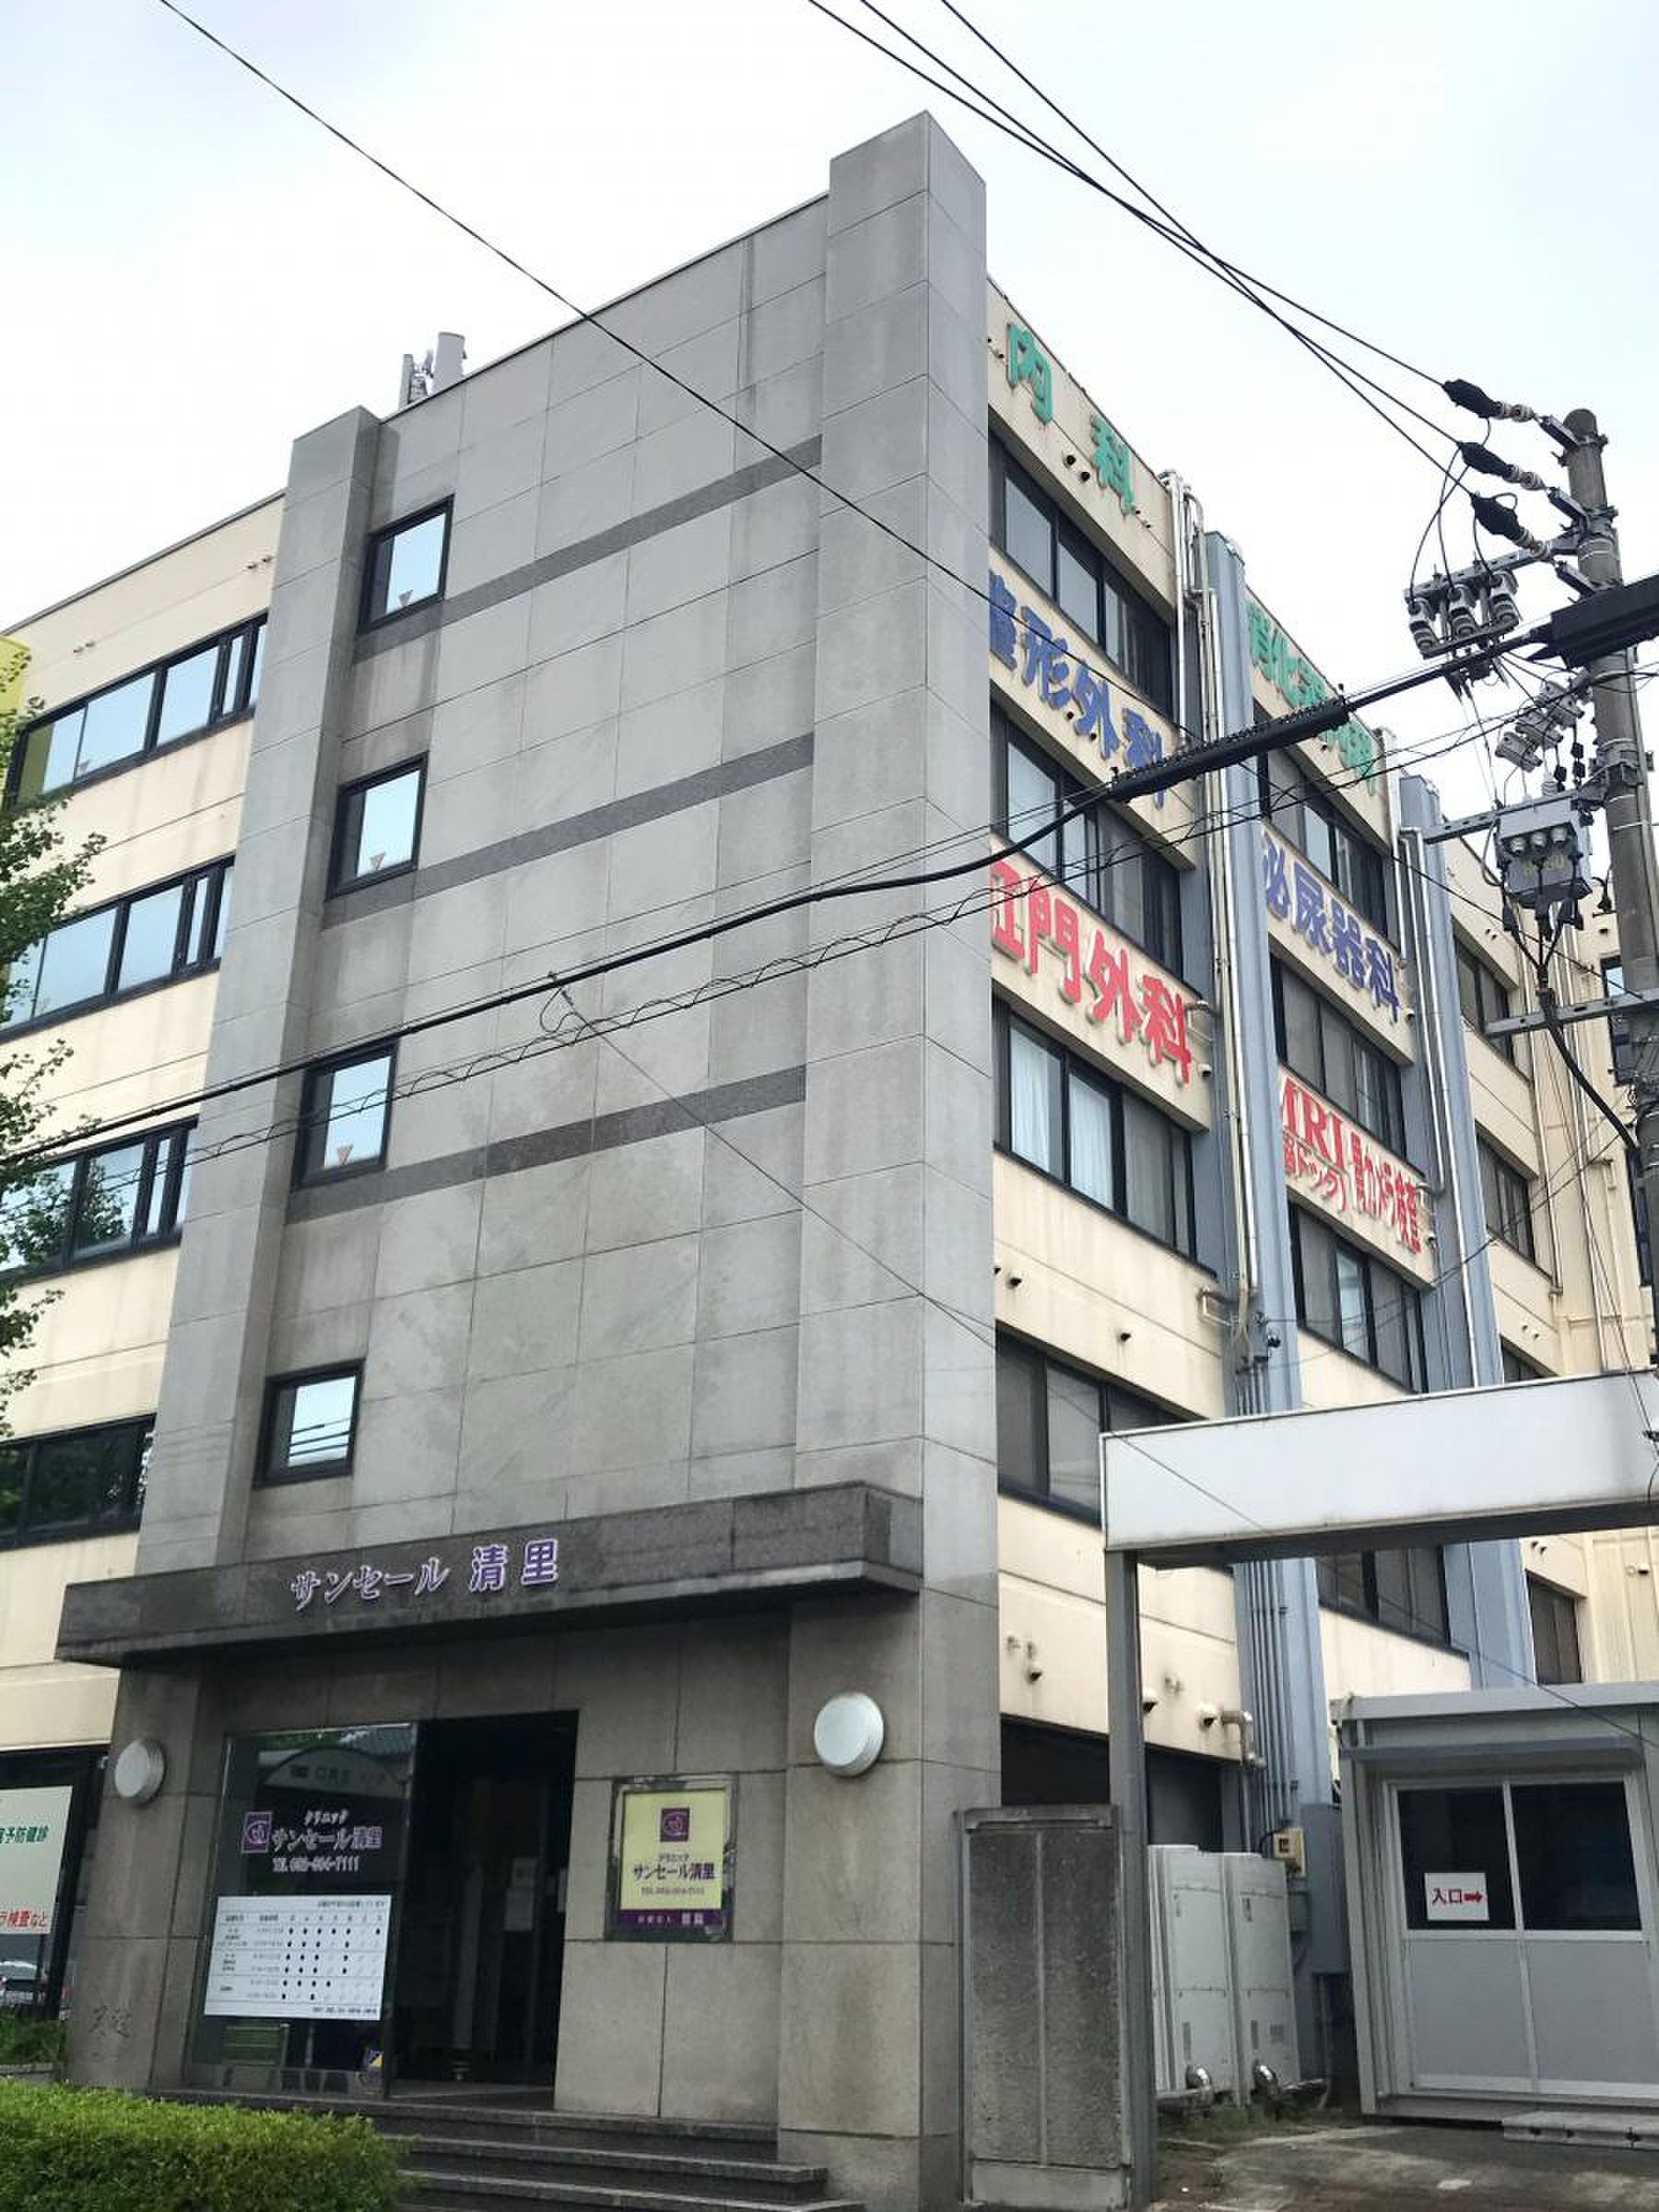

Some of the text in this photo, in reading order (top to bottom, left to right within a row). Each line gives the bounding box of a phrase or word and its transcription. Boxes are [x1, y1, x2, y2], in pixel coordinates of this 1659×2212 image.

[1006, 322, 1135, 516] 内科
[290, 1537, 559, 1611] サンセール 清里
[633, 1862, 715, 1881] サンセール清里
[1431, 1888, 1463, 1905] 入口
